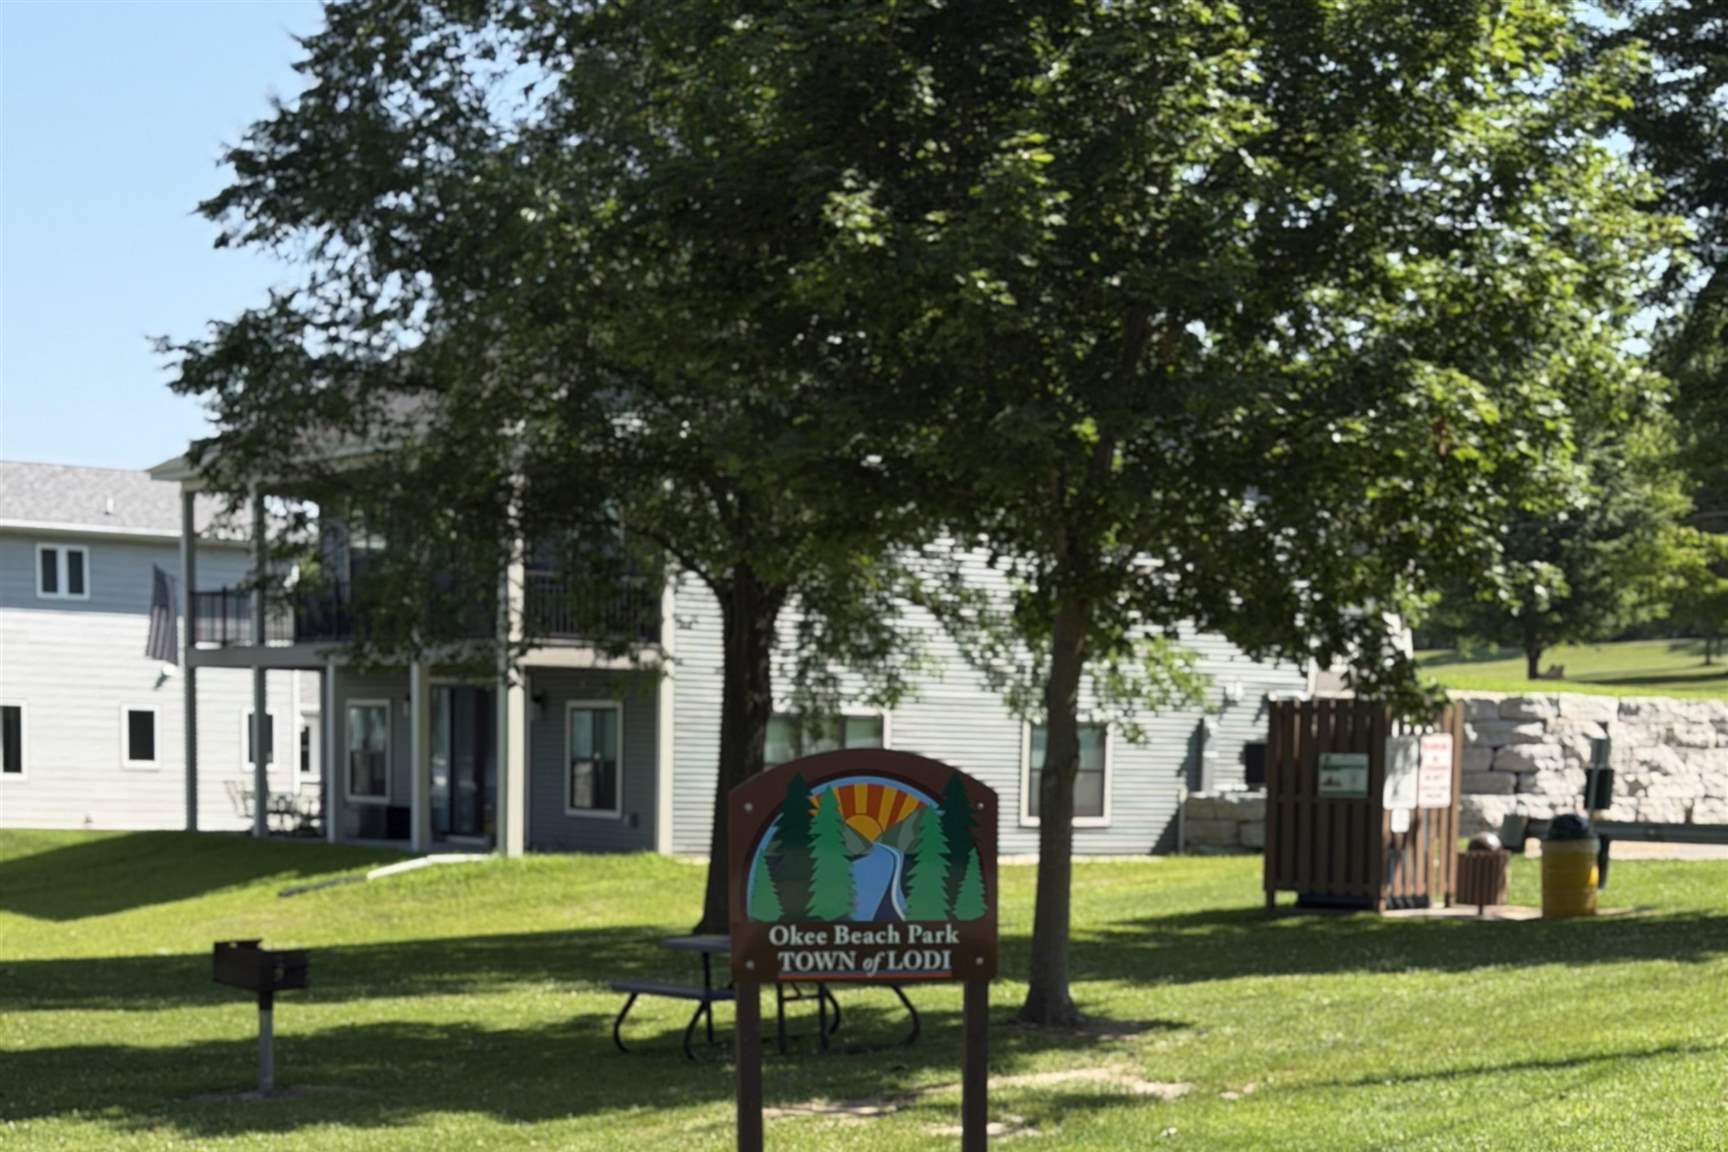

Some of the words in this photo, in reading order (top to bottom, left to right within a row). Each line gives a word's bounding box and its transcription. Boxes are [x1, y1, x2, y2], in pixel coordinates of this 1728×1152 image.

[768, 924, 828, 946] Okee
[833, 924, 901, 945] Beach
[907, 923, 960, 945] Park
[777, 951, 857, 972] TOWN
[862, 951, 884, 977] of
[887, 950, 953, 971] LODI
